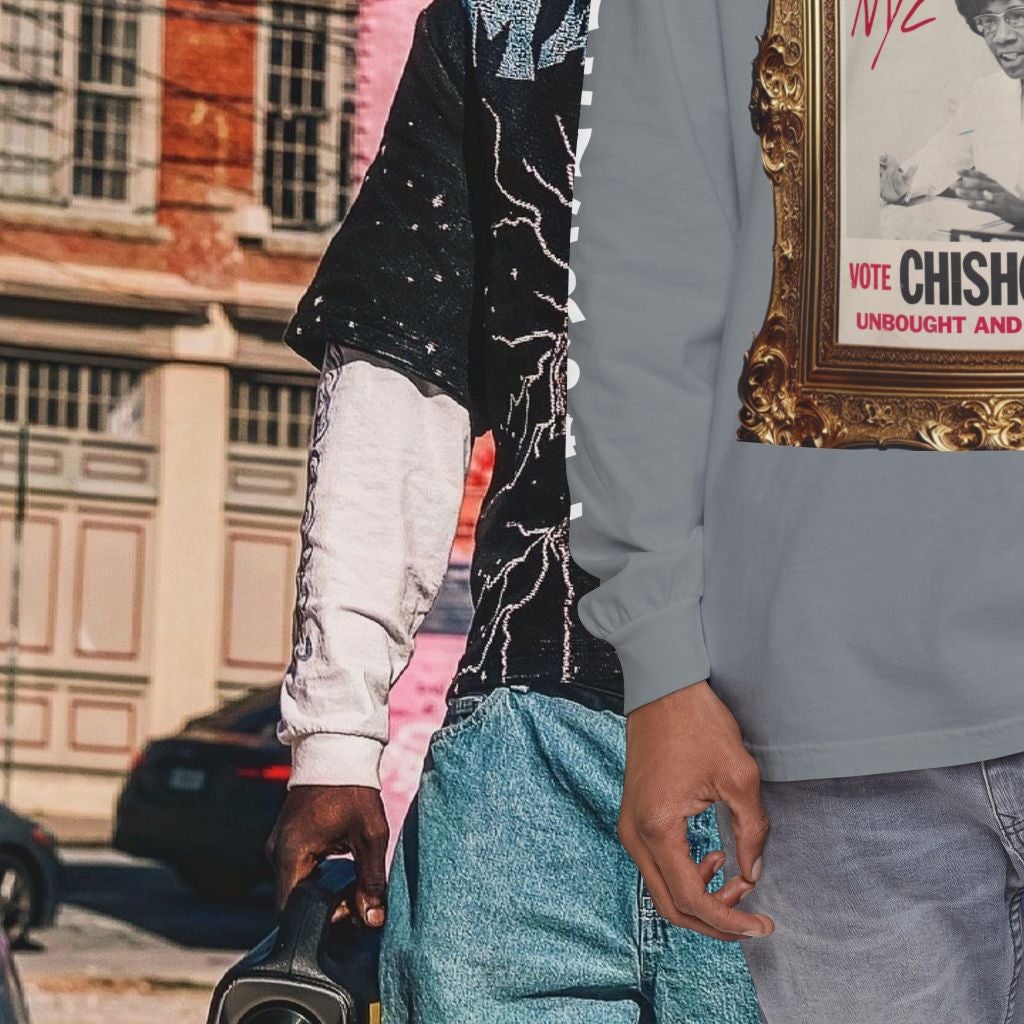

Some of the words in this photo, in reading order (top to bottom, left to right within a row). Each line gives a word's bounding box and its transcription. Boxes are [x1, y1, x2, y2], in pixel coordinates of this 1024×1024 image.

[849, 262, 892, 291] VOTE
[856, 312, 967, 334] UNBOUGHT
[974, 316, 1023, 334] AND
